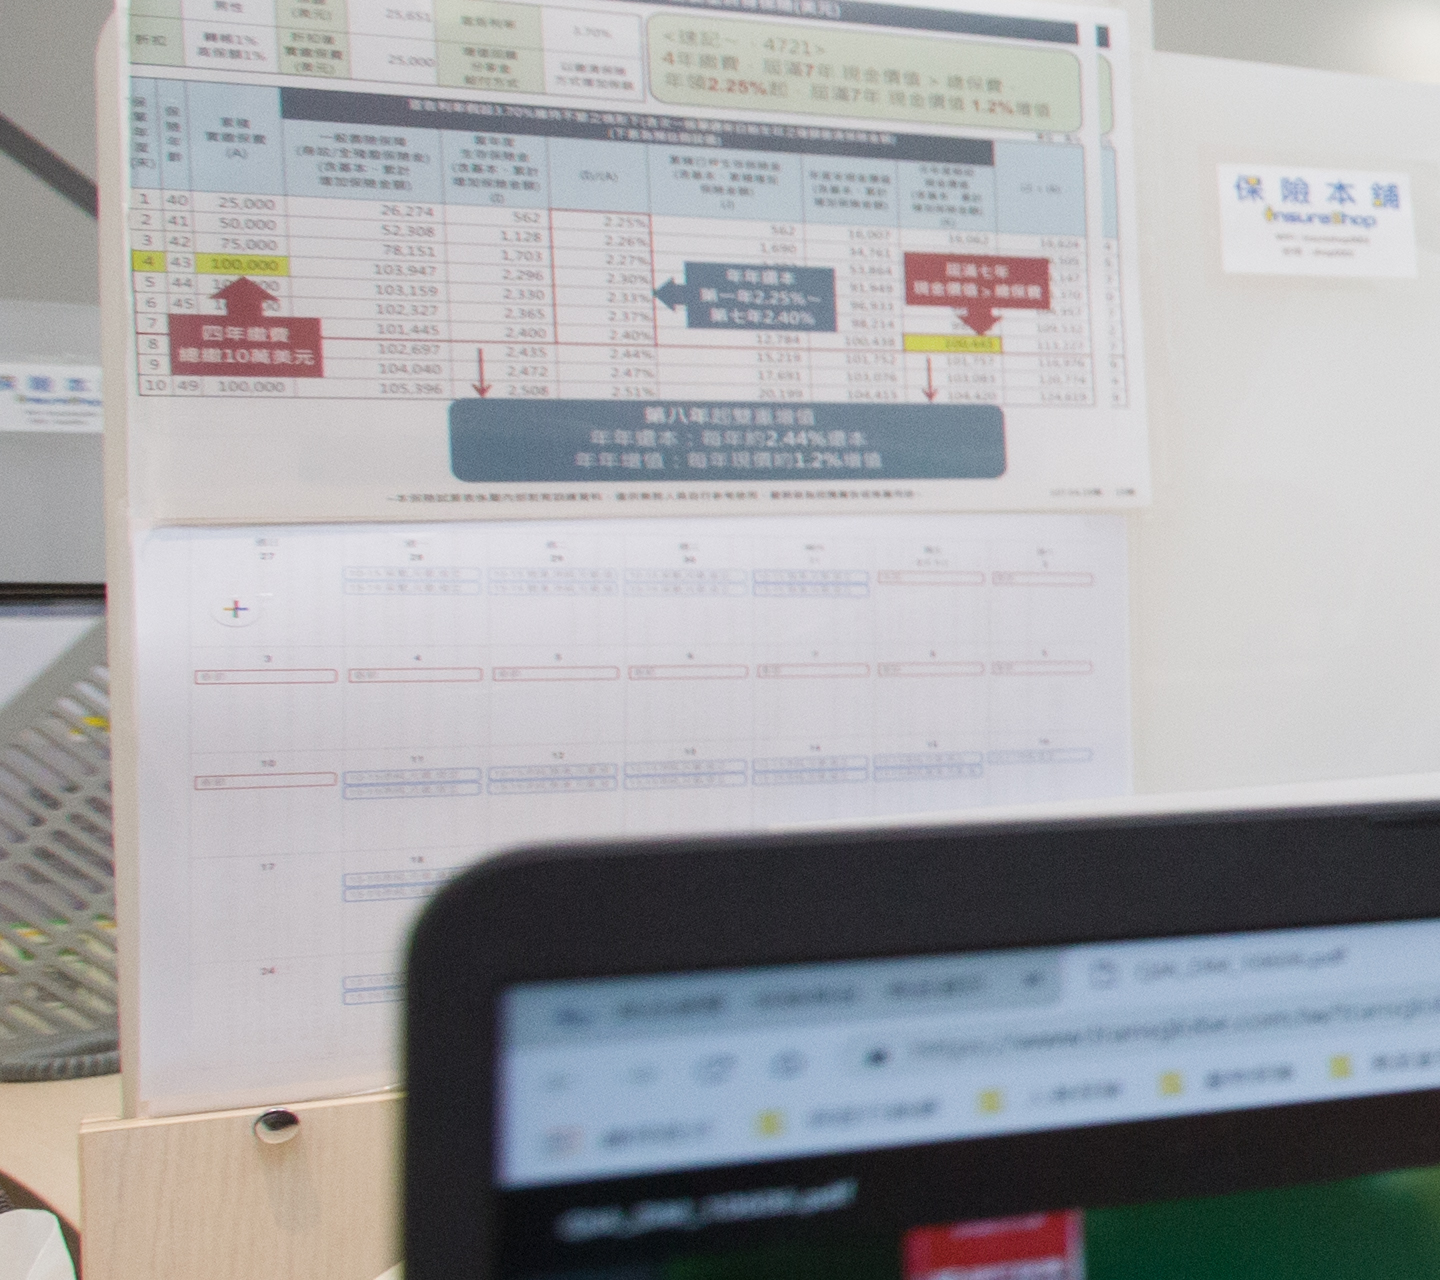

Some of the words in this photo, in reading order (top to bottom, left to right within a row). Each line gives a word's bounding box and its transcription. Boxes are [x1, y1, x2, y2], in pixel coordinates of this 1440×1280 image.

[167, 194, 189, 208] 40
[219, 197, 275, 211] 25,000
[220, 218, 277, 231] 50,000
[169, 235, 191, 248] 42
[221, 238, 277, 251] 75,000
[170, 256, 192, 269] 43
[172, 278, 193, 289] 44
[173, 298, 194, 310] 45
[146, 379, 167, 391] 10
